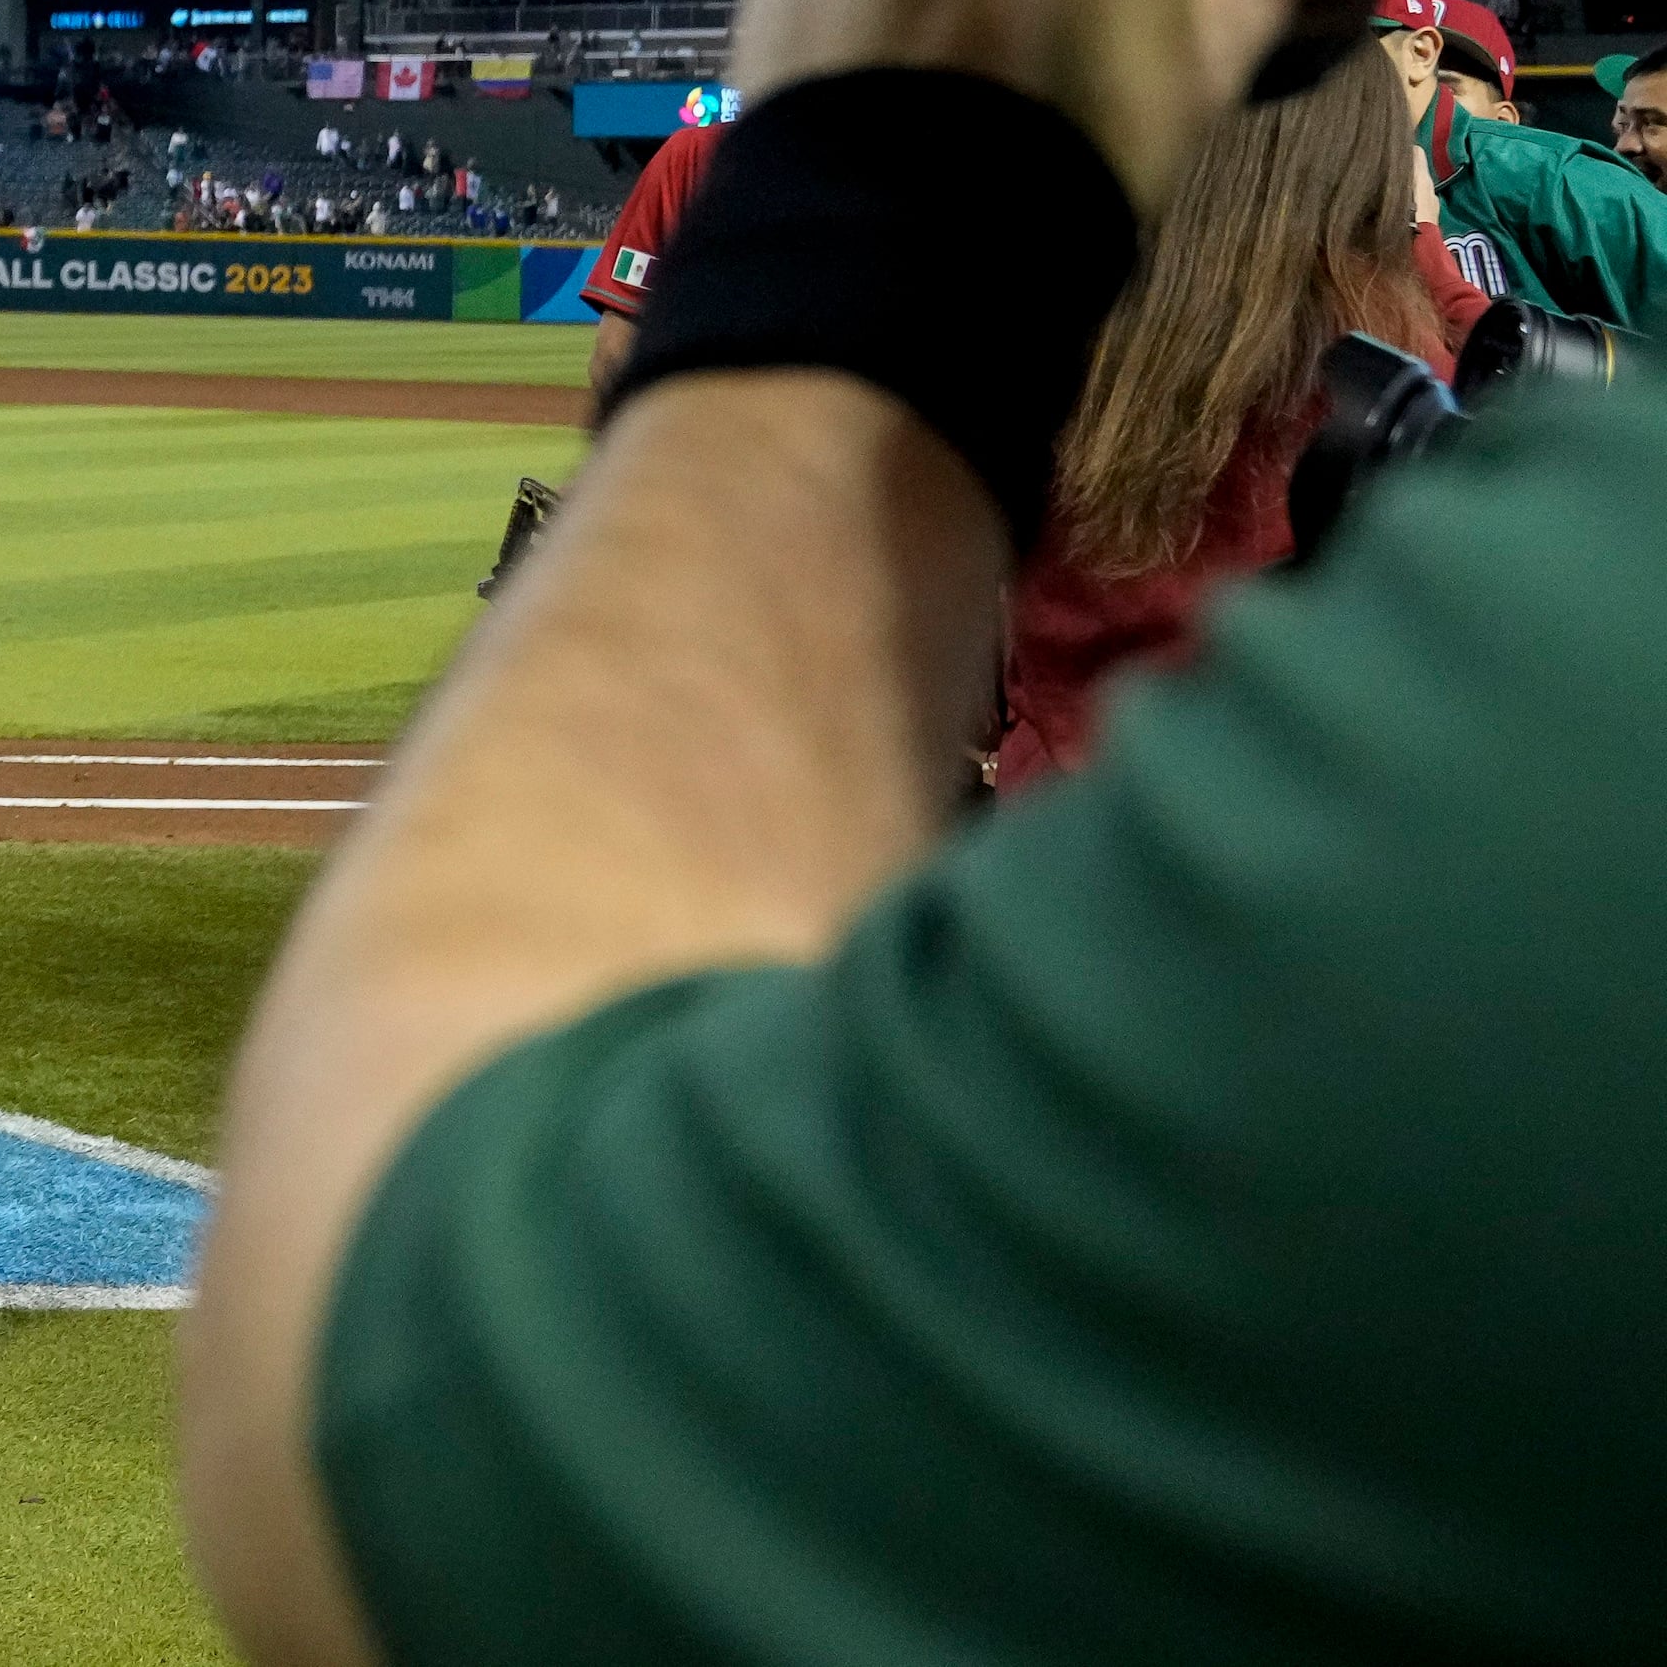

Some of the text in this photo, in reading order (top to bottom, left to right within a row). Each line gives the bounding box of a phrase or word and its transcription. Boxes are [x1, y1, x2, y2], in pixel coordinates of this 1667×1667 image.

[343, 250, 436, 271] KONAMI
[59, 259, 216, 293] CLASSIC
[224, 264, 314, 295] 2023
